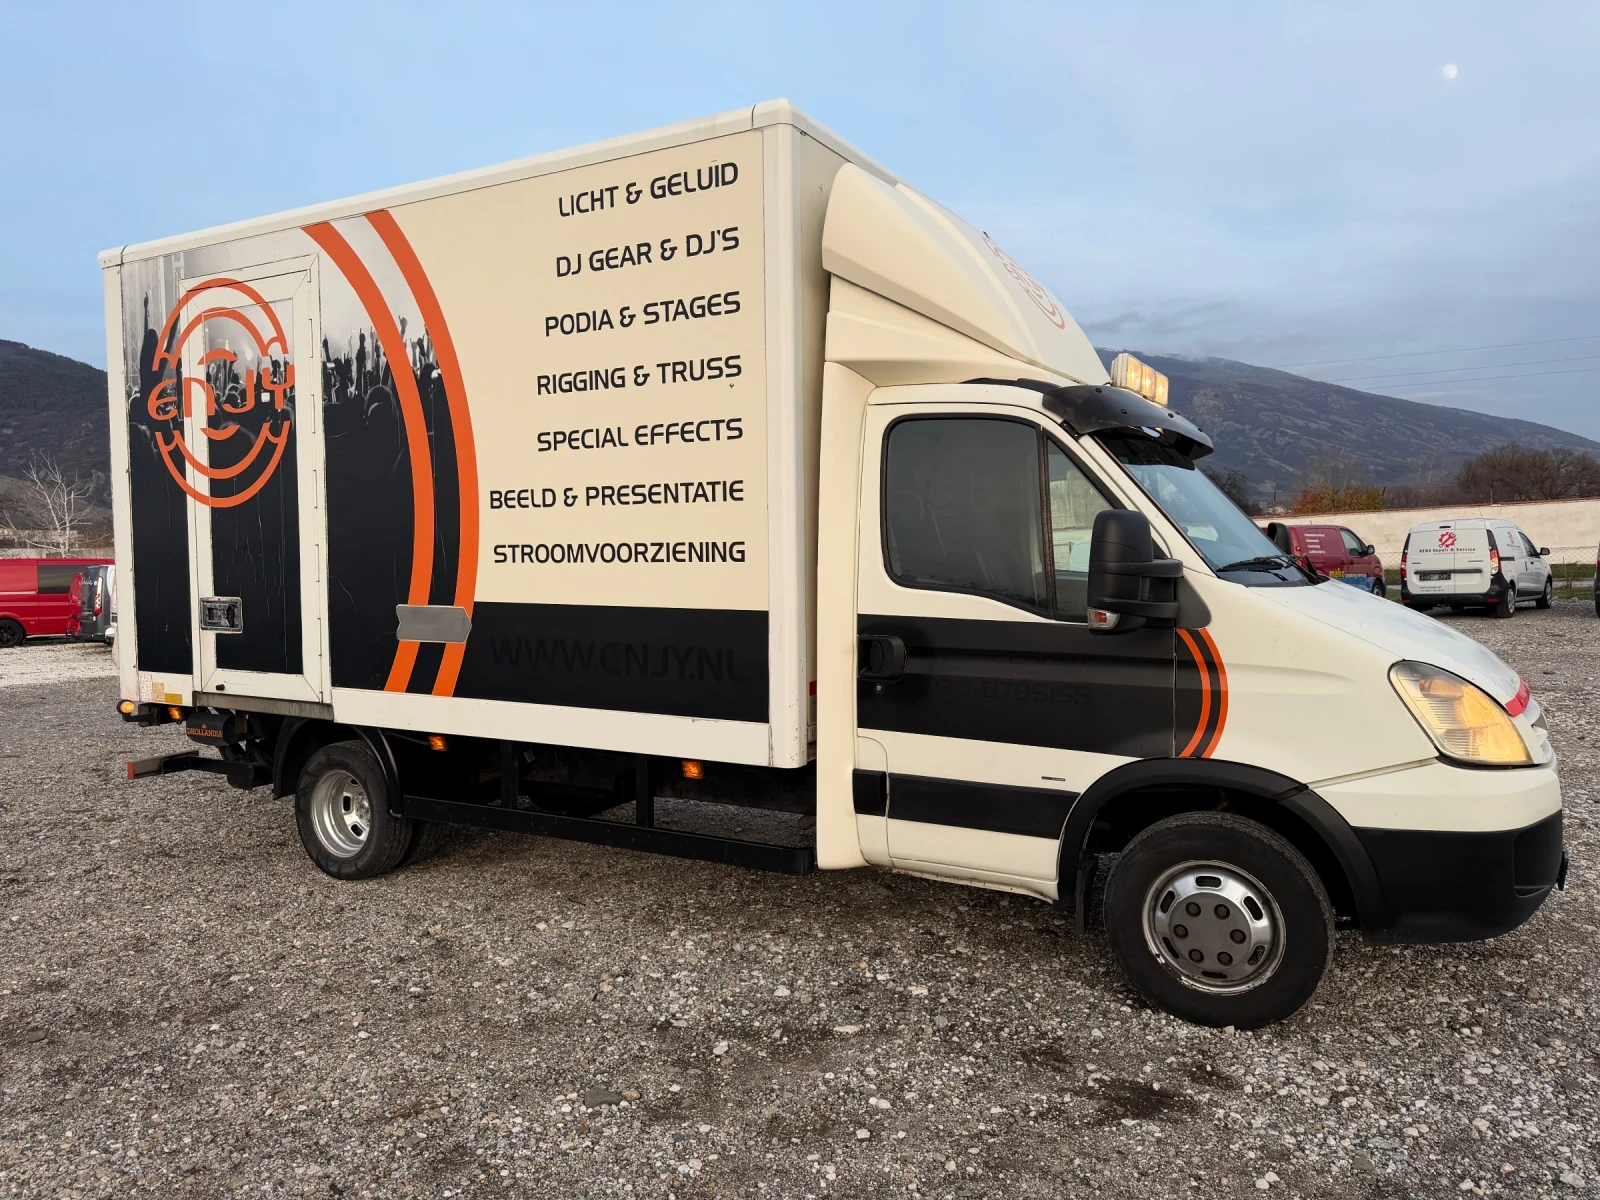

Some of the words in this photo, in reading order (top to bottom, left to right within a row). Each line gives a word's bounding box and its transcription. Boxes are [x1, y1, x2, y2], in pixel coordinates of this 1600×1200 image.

[559, 186, 618, 217] LICHT
[626, 182, 642, 204] &
[650, 163, 738, 199] GELUID
[557, 254, 581, 277] DJ
[588, 243, 652, 271] GEAR
[660, 239, 677, 261] &
[686, 227, 739, 257] DJ'S
[546, 309, 614, 337] PODIA
[620, 306, 636, 327] &
[643, 291, 740, 324] STAGES
[537, 367, 625, 395] RIGGING
[634, 365, 650, 386] &
[657, 355, 741, 383] TRUSS
[537, 427, 629, 451] SPECIAL
[635, 418, 743, 445] EFFECTS
[490, 489, 556, 509] BEELD
[564, 488, 578, 507] &
[586, 480, 743, 506] PRESENTATIE
[494, 541, 745, 563] STROOMVOORZIENING
